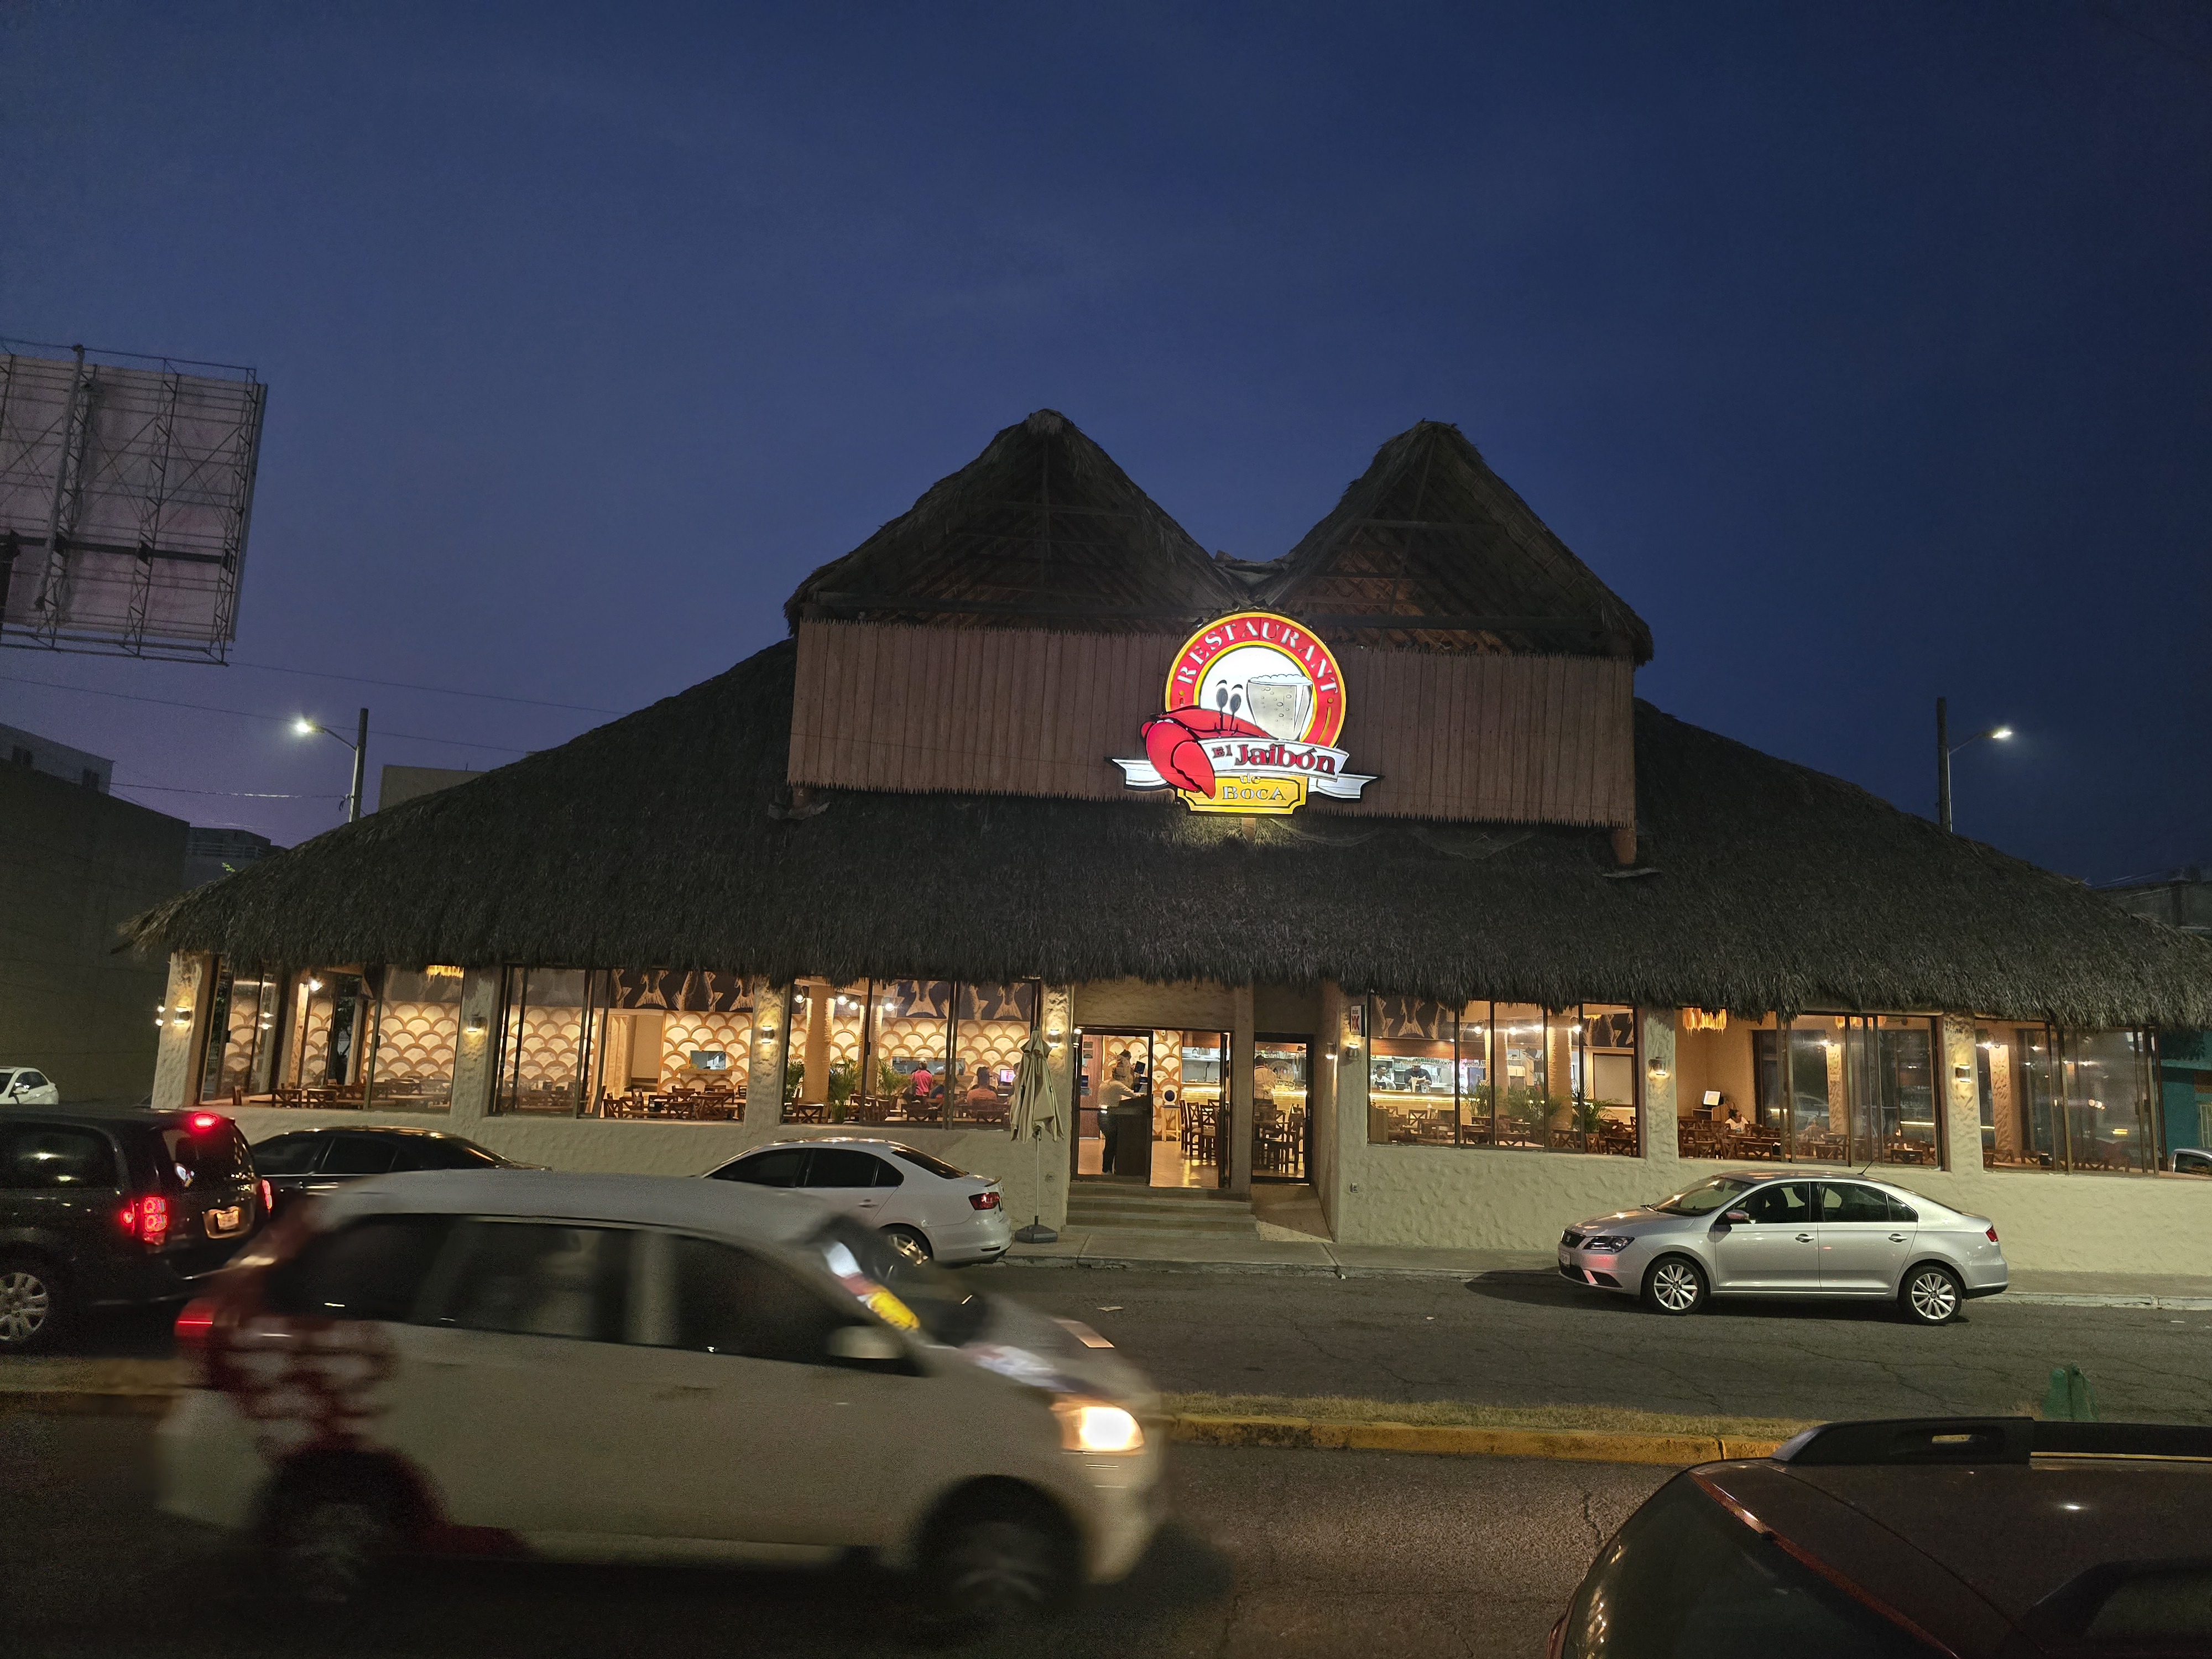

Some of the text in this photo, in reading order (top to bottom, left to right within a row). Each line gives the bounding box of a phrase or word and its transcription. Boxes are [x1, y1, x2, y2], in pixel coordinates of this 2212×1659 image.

[1177, 620, 1339, 695] RESTAURANT
[1212, 744, 1336, 775] El Jaibón
[1240, 773, 1261, 784] de
[1222, 786, 1287, 801] BOCA
